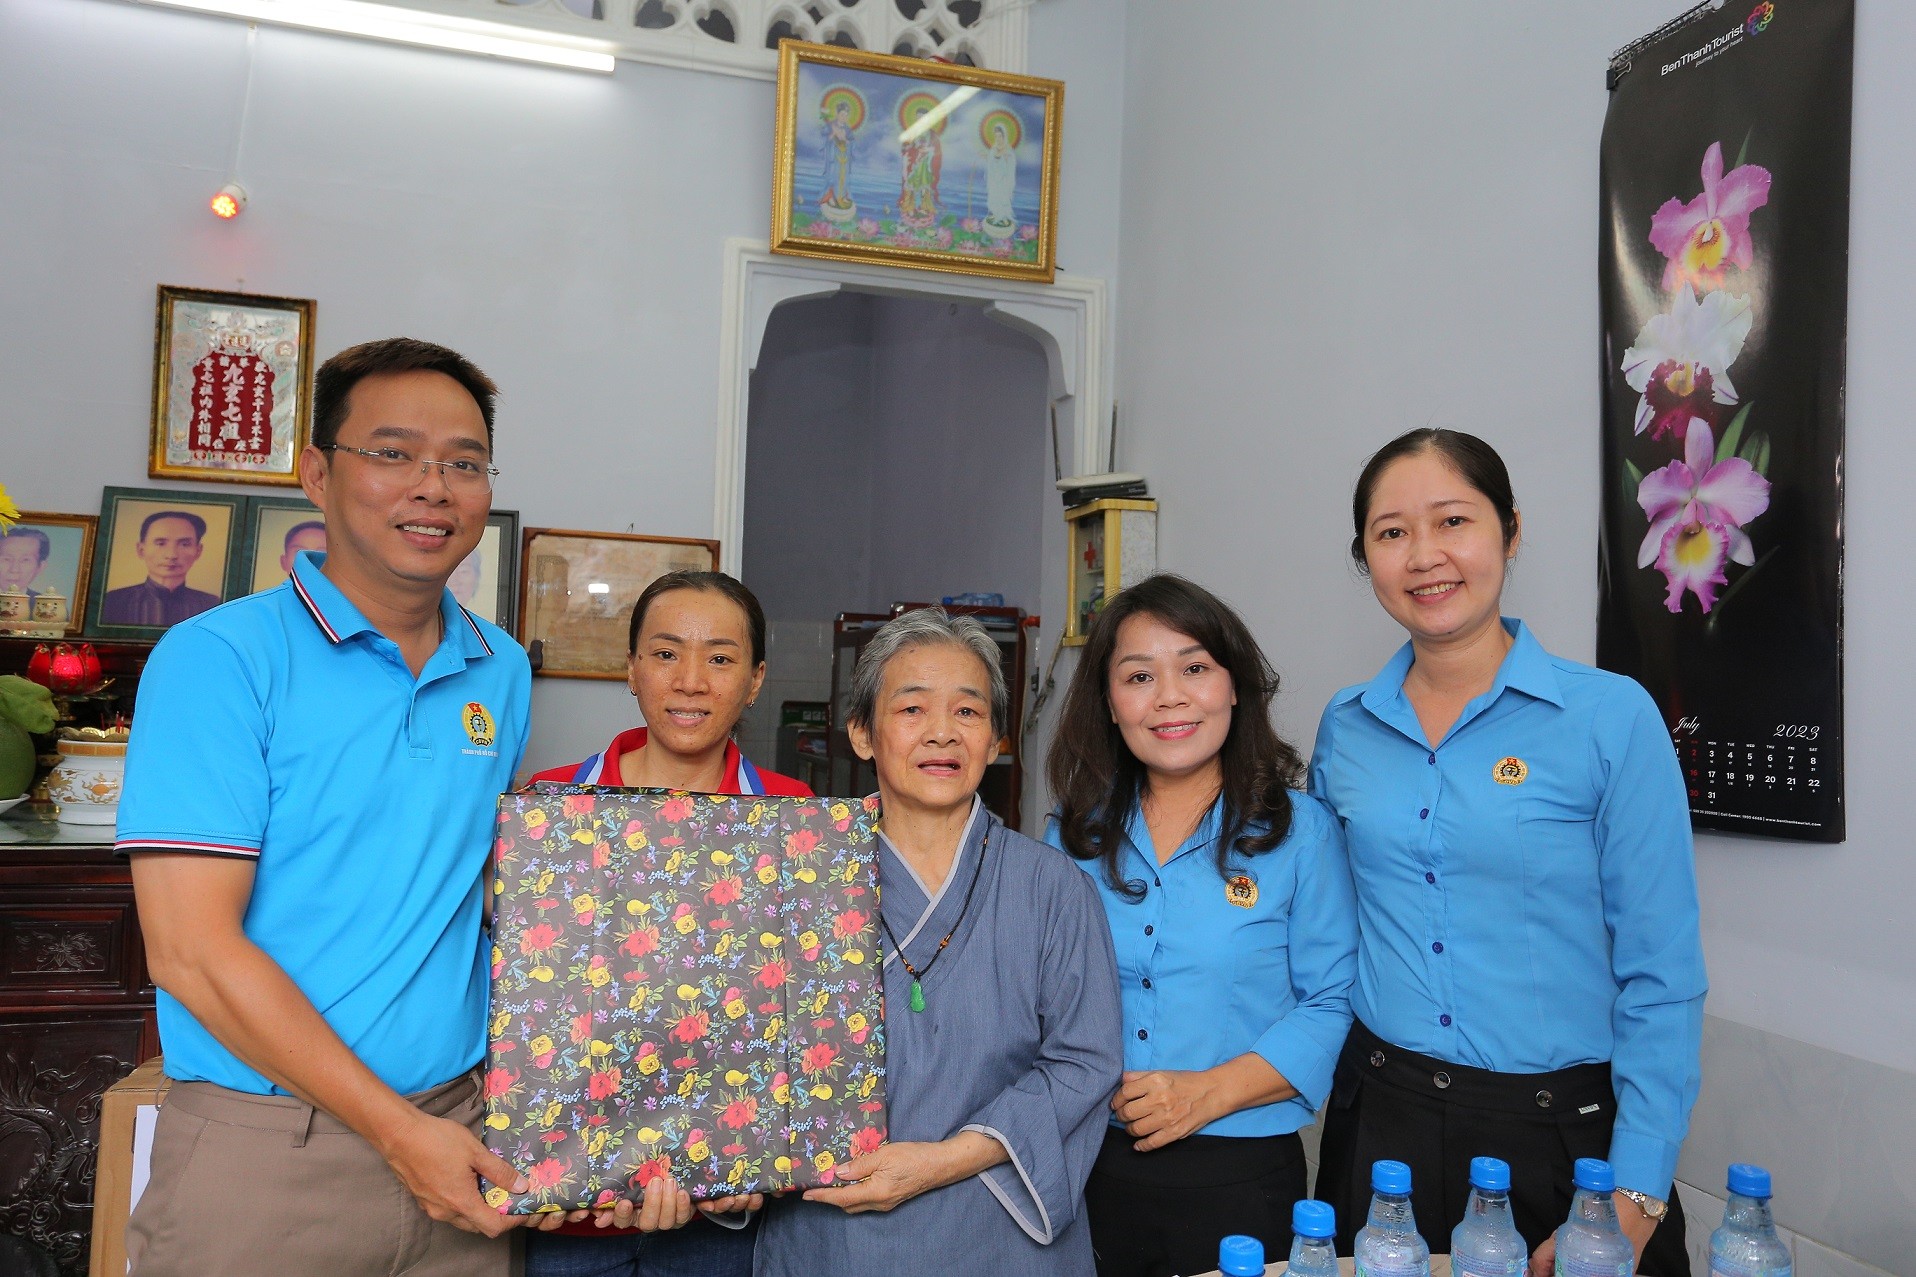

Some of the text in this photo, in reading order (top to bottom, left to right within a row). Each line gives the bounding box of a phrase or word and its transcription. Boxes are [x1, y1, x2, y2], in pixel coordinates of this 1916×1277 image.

[1672, 716, 1820, 740] July 2023
[1727, 751, 1733, 759] 4
[1767, 754, 1773, 762] 6
[1788, 755, 1794, 763] 7
[1810, 757, 1816, 765] 8
[1708, 770, 1716, 778] 17
[1764, 775, 1776, 783] 20
[1786, 777, 1796, 785] 21
[1808, 779, 1820, 787] 22
[1707, 791, 1716, 799] 31
